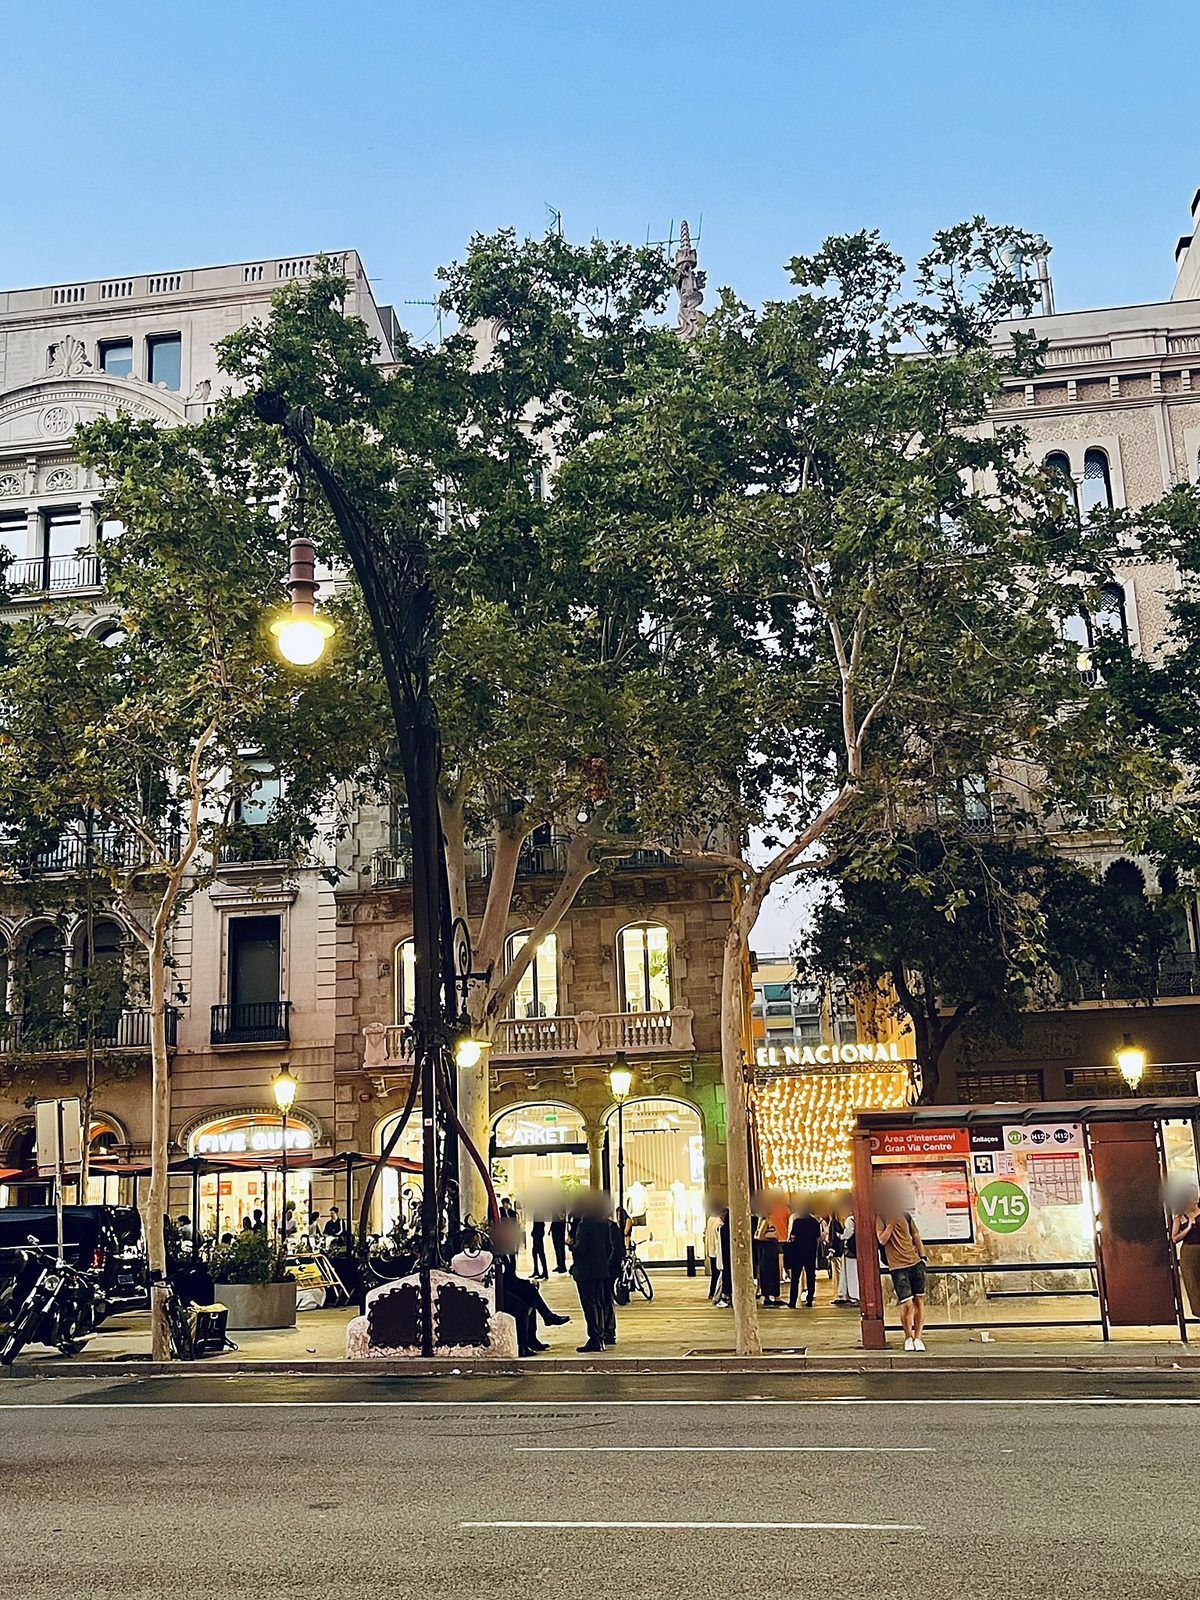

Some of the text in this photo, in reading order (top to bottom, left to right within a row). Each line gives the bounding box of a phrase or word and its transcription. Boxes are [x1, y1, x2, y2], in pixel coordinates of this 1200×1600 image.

[756, 1042, 902, 1066] EL NACIONAL
[199, 1130, 312, 1153] FIVE GUYS
[513, 1127, 569, 1145] ARKET
[885, 1142, 952, 1152] Gran Via Centre
[980, 1195, 1026, 1217] V15
